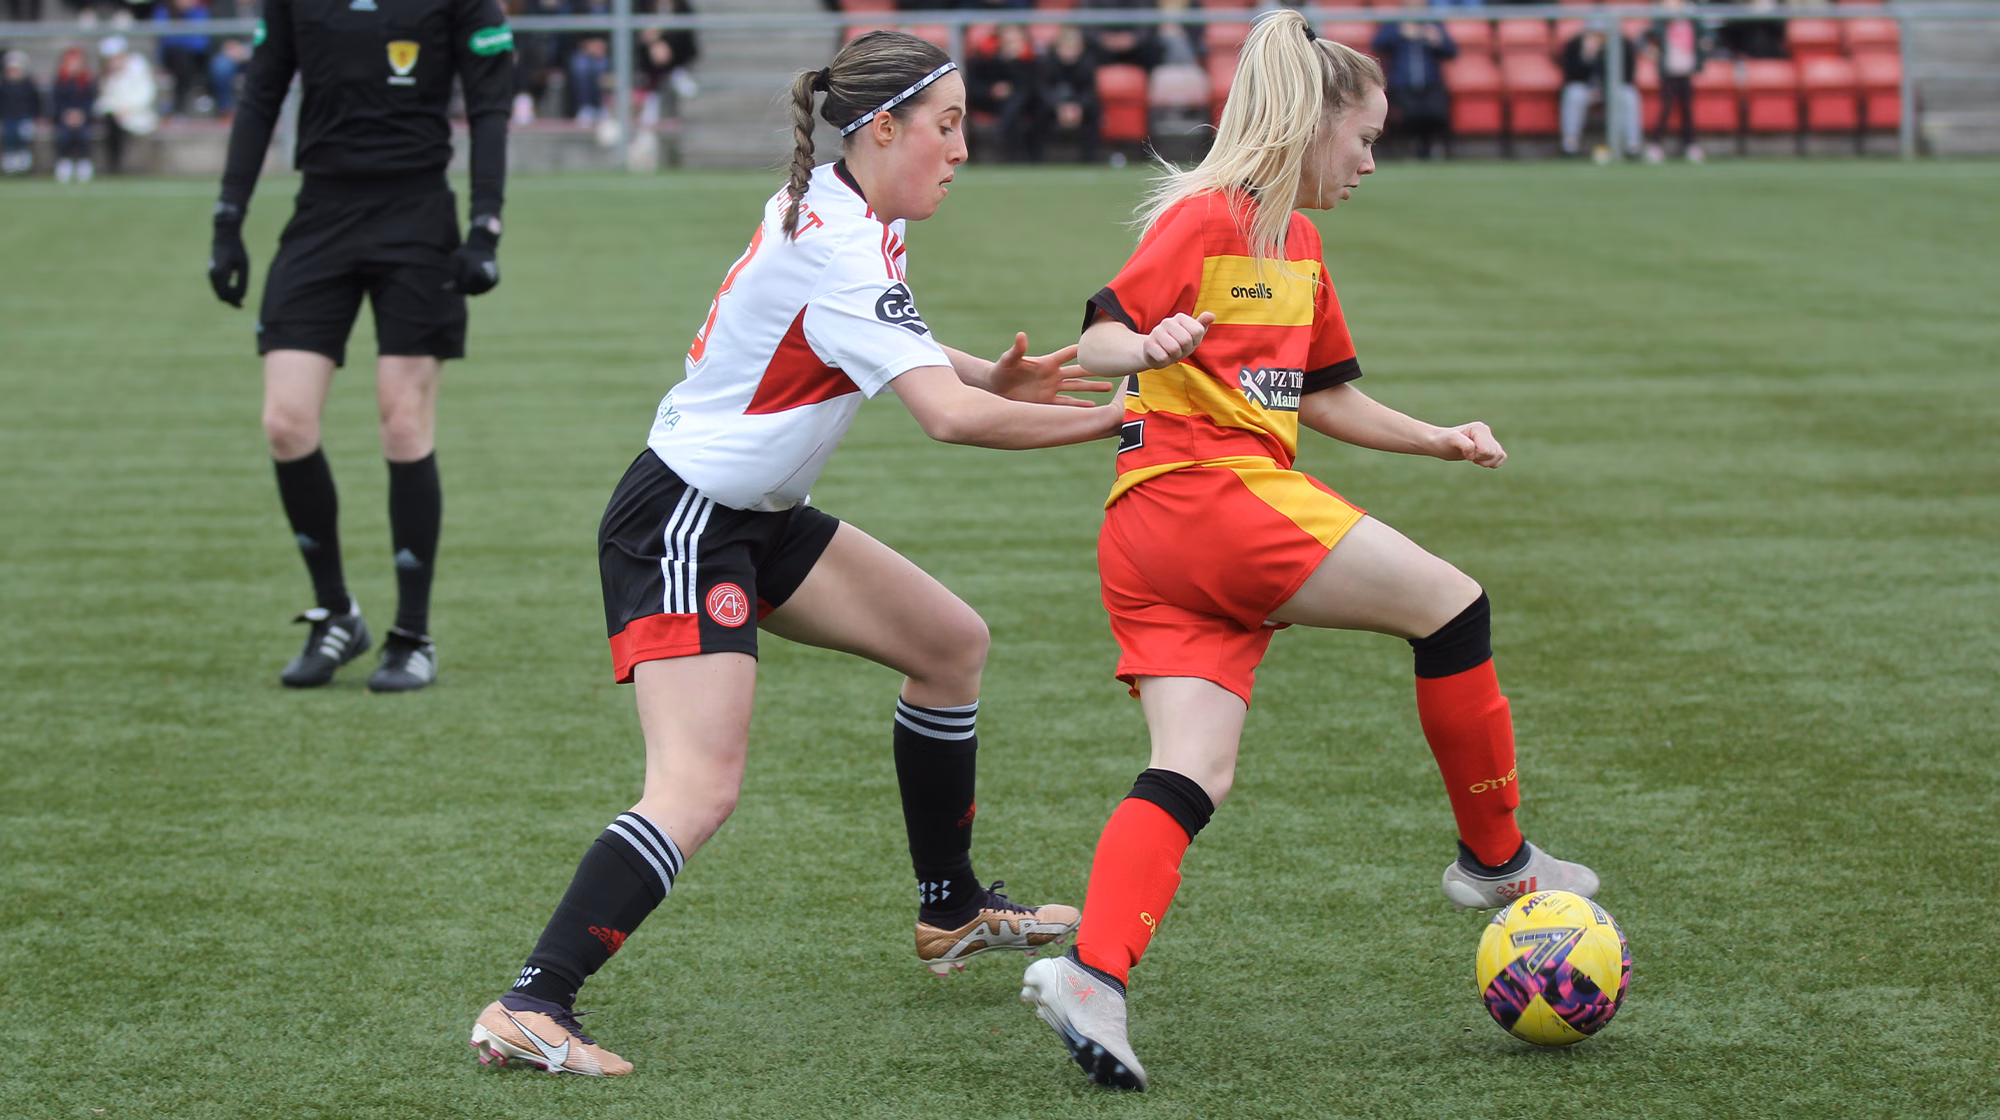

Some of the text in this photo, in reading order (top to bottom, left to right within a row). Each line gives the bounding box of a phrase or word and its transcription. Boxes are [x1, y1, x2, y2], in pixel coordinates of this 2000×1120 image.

[892, 93, 905, 104] NIKE
[913, 80, 925, 92] NIKE
[1269, 371, 1287, 388] PZ
[1469, 759, 1517, 793] o'ne
